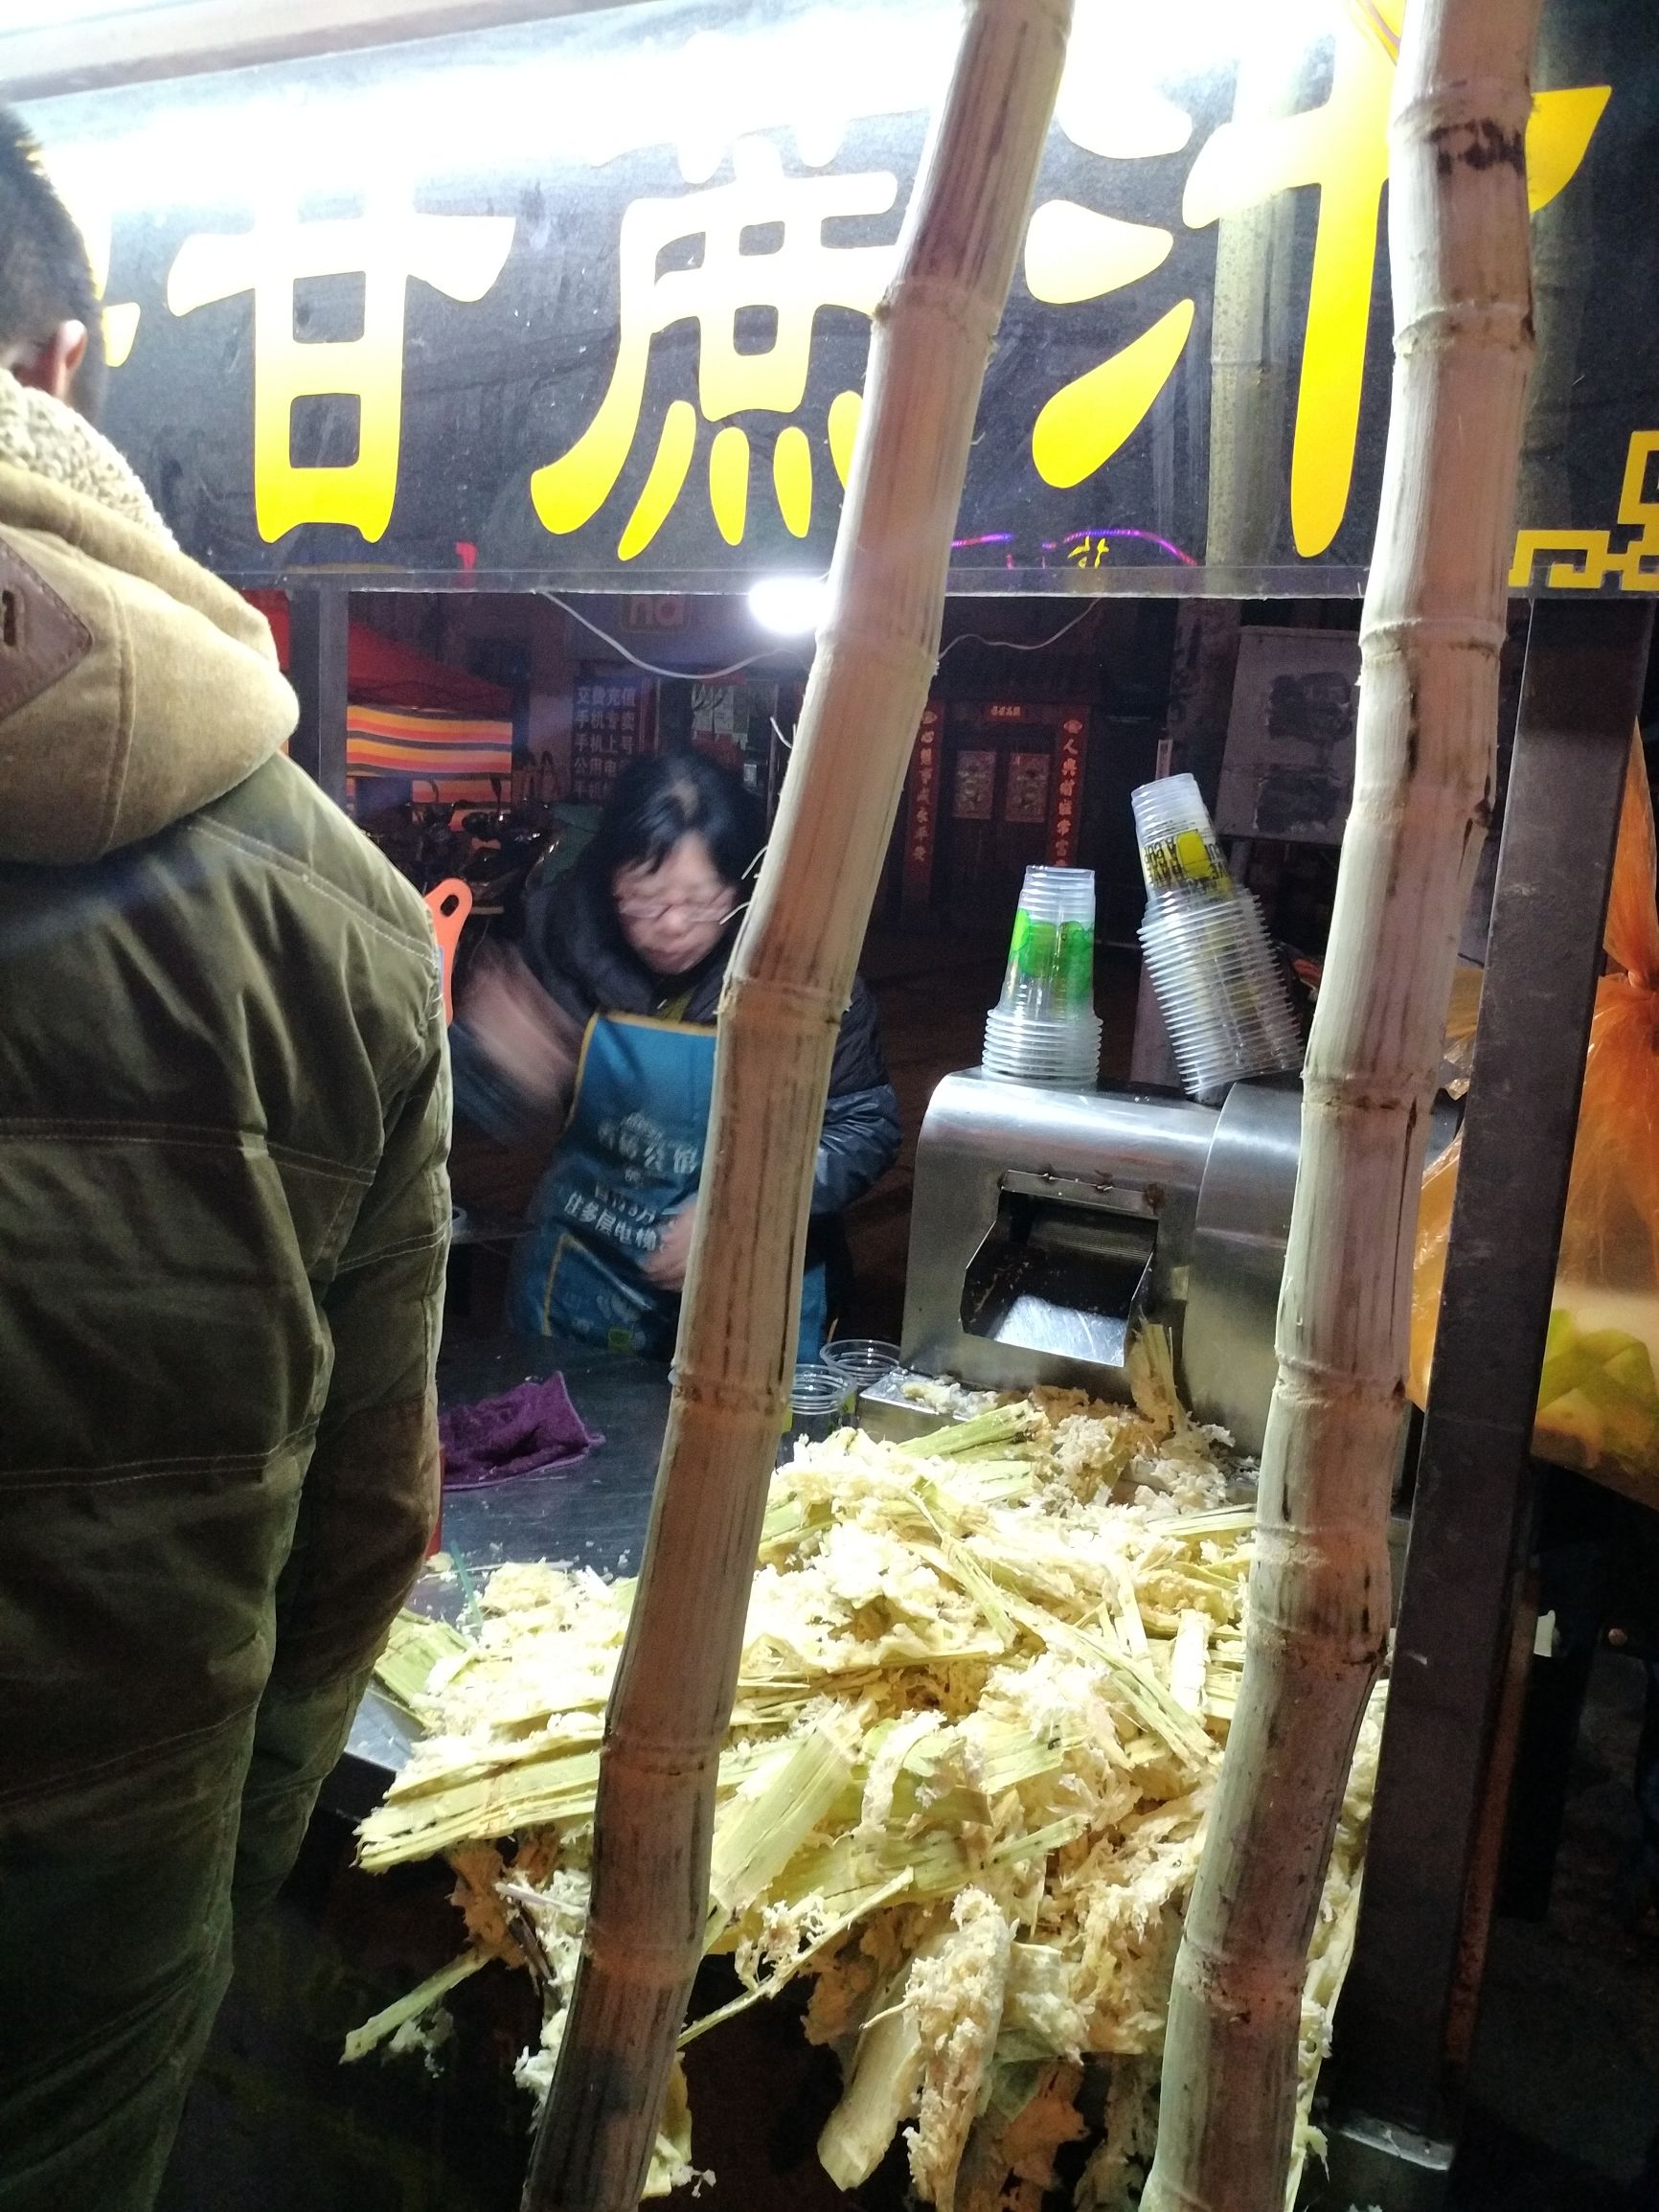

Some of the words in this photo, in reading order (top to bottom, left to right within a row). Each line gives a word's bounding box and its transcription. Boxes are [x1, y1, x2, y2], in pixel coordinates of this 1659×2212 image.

[91, 11, 1612, 560] 甘蔗汁
[573, 780, 615, 800] 手机
